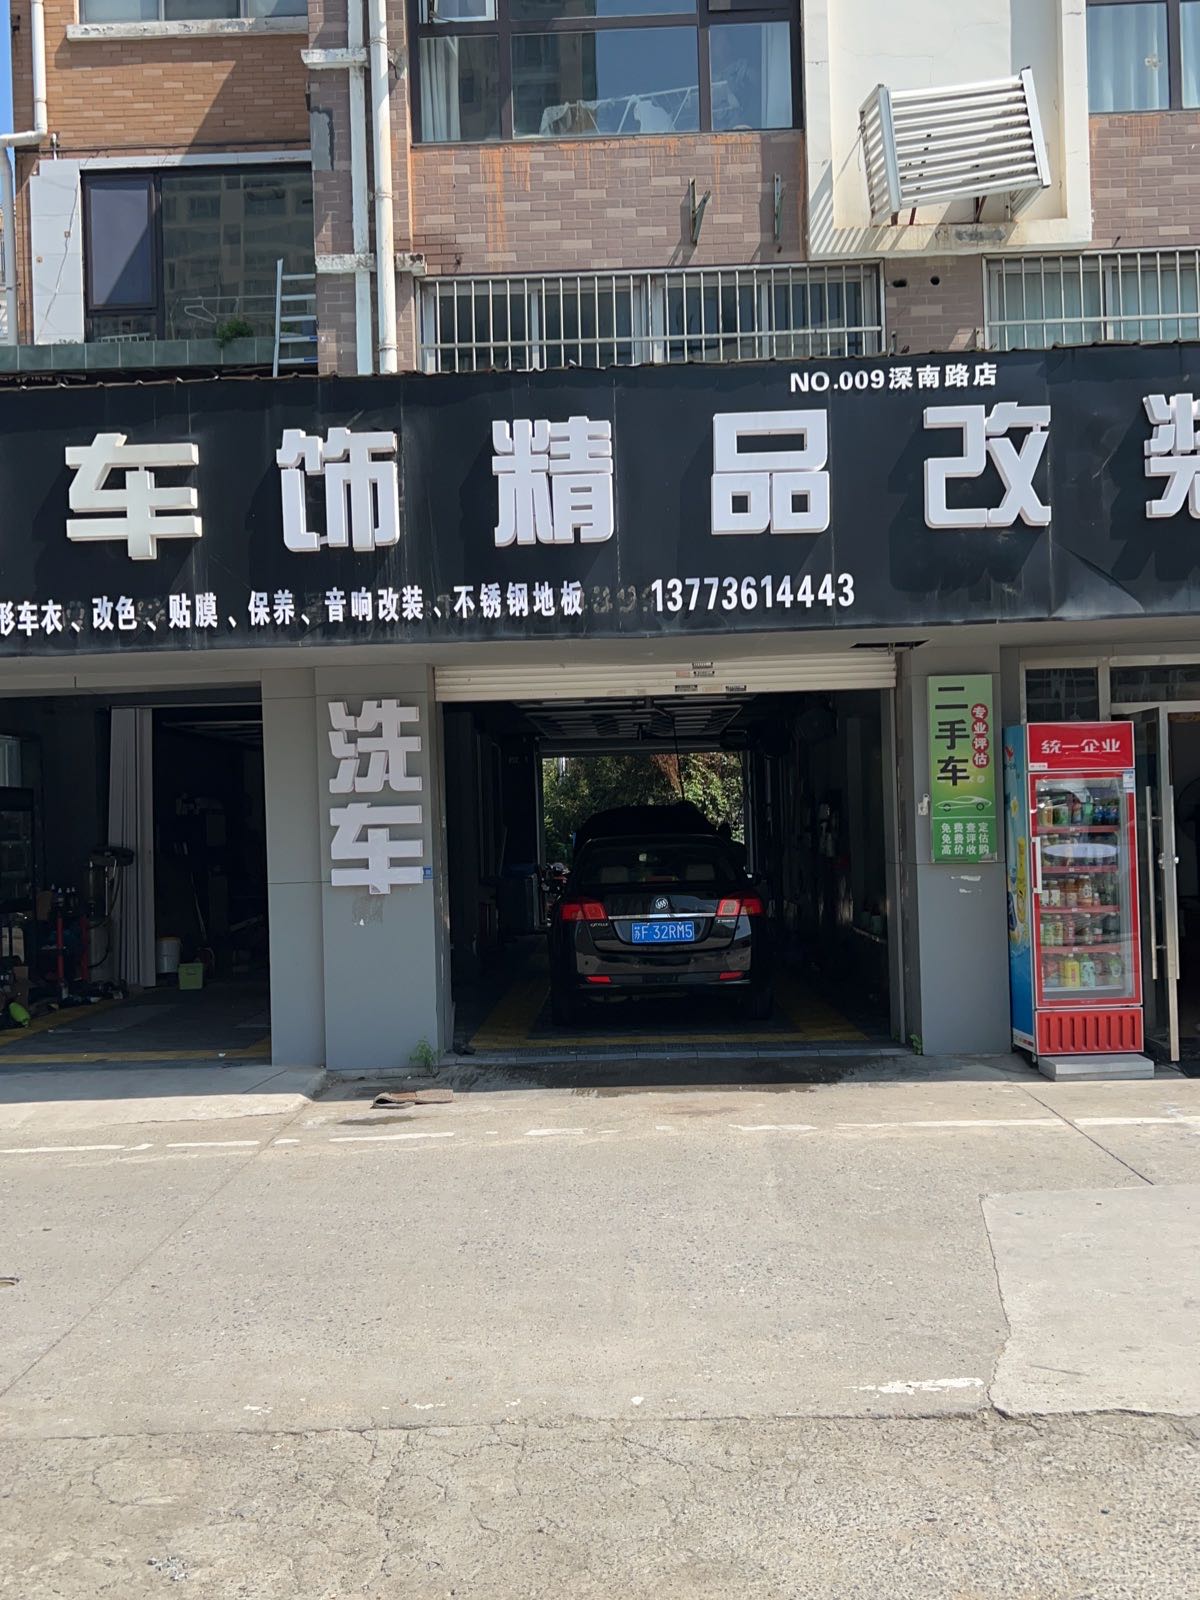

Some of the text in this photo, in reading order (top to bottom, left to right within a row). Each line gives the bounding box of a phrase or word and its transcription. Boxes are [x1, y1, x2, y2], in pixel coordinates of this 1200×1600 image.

[790, 362, 997, 393] NO.009深南路店
[651, 573, 855, 612] 13773614443
[935, 686, 970, 786] 二手车
[972, 704, 988, 766] 专业评估
[1041, 738, 1121, 754] 统一企业
[328, 699, 423, 895] 洗车
[941, 833, 989, 844] 免费评估
[941, 845, 990, 855] 高价收购
